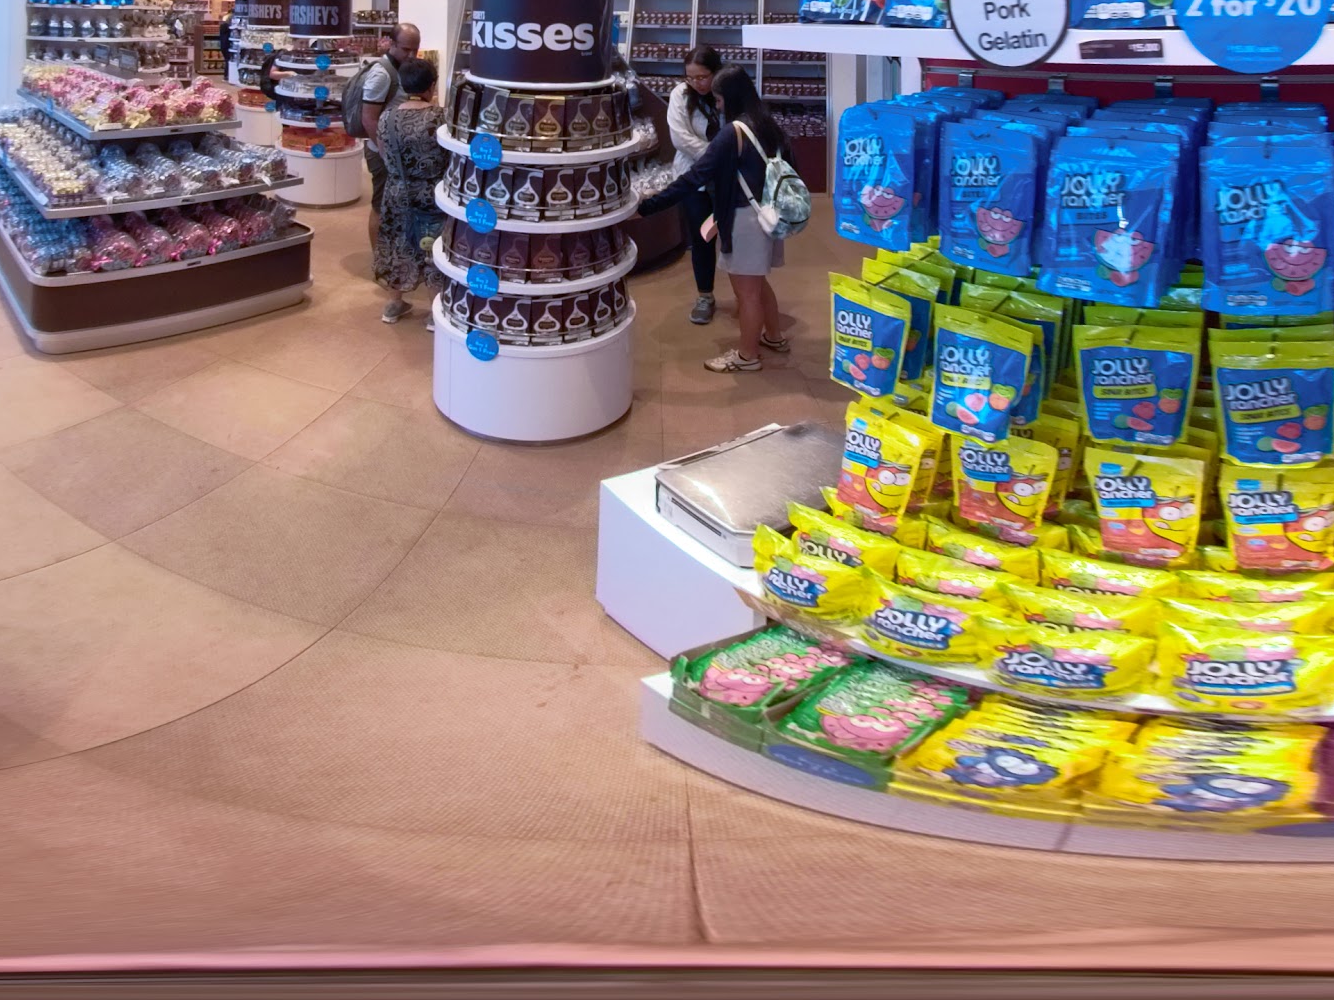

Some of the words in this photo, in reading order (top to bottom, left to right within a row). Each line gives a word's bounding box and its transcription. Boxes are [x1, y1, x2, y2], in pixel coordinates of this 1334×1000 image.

[248, 4, 282, 20] ERSHEY'S
[290, 5, 339, 26] ERSHEY'S
[983, 0, 1031, 21] Pork
[978, 29, 1048, 52] Gelatin
[953, 174, 1001, 187] ancher
[837, 310, 871, 330] OLLY
[837, 325, 873, 339] ancher
[1091, 357, 1149, 376] JOLLY
[1225, 376, 1290, 400] JOLLY
[1228, 490, 1290, 510] JOLLY
[877, 607, 948, 632] JOLLY
[1187, 659, 1276, 677] JOLLY
